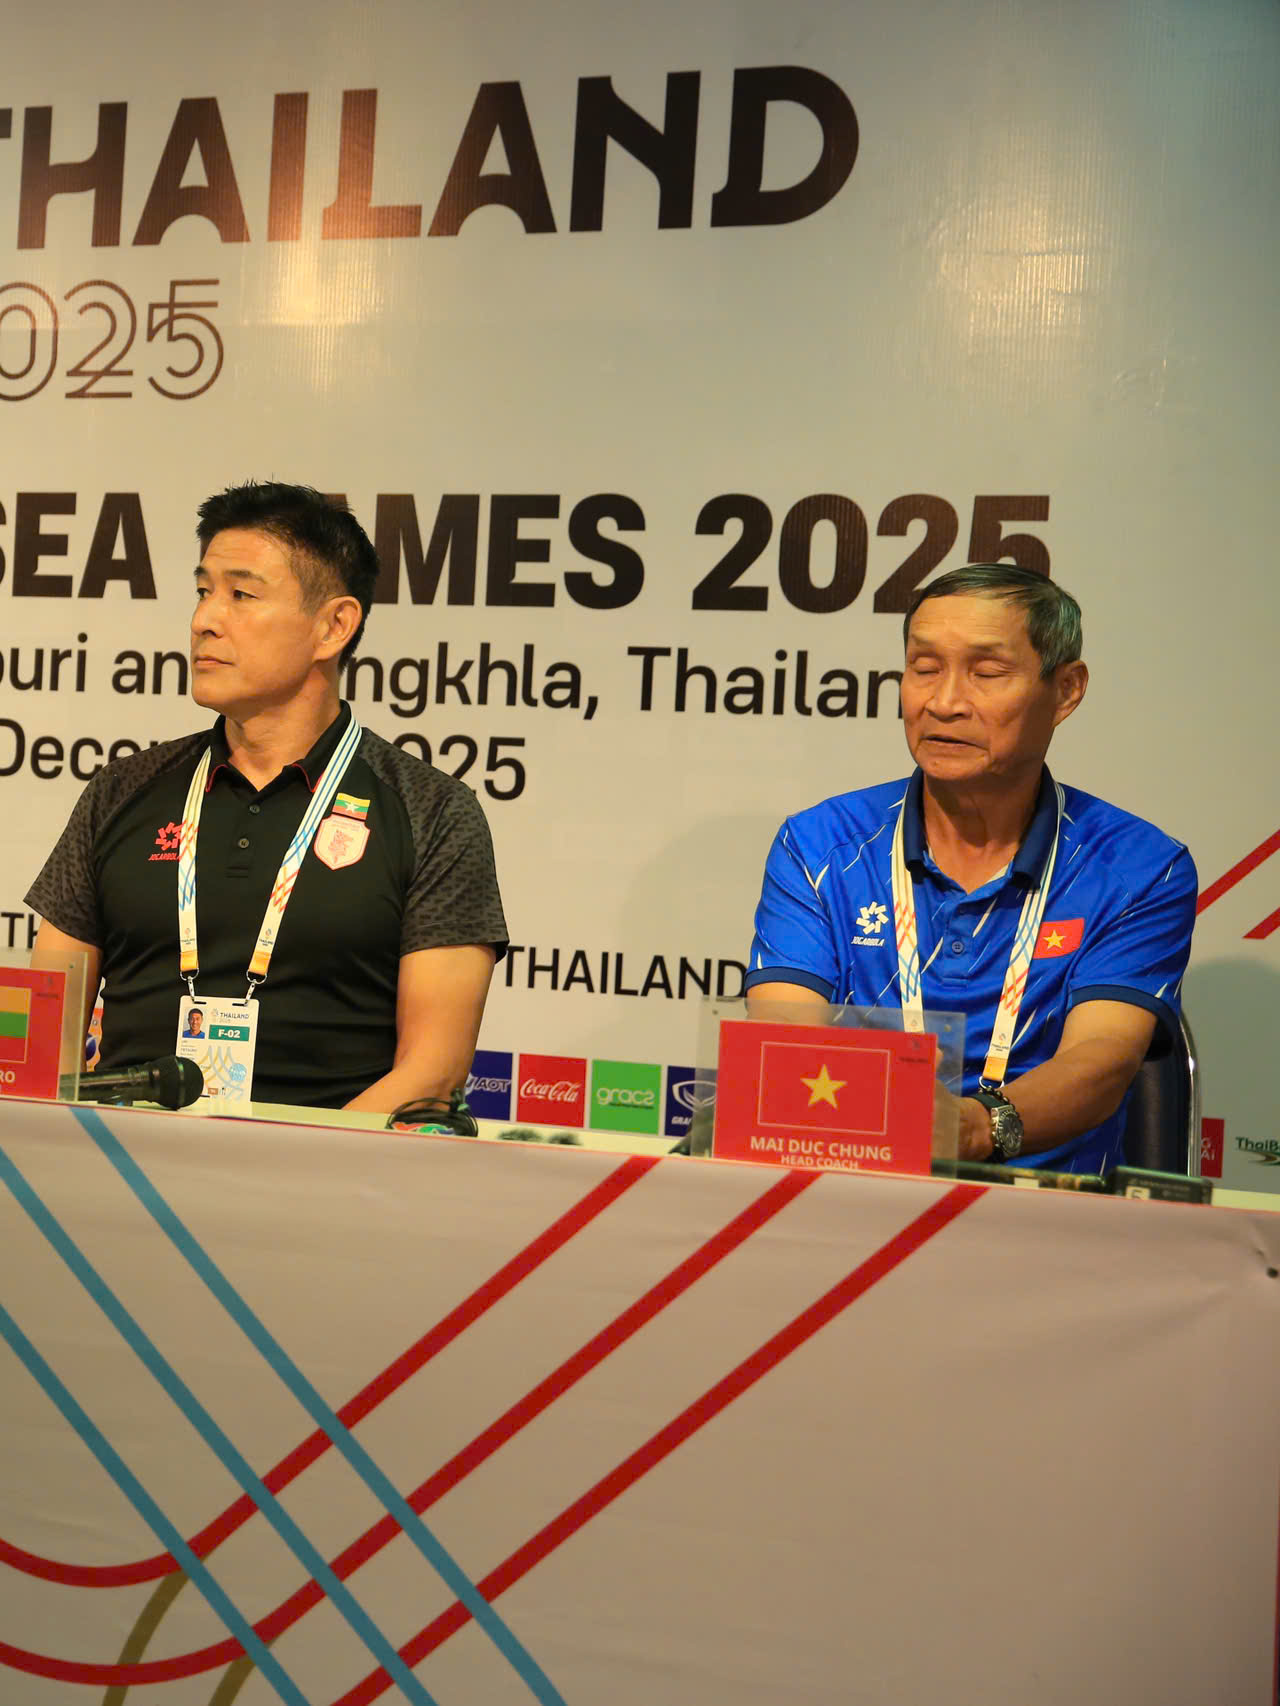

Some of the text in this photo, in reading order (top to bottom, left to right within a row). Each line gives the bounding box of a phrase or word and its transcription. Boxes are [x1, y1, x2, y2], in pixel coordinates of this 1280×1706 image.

[691, 493, 1051, 614] 2025
[626, 645, 904, 720] Thailan
[505, 945, 748, 1002] THAILAND
[219, 1012, 249, 1020] THAILAND
[217, 1029, 241, 1039] F-02
[476, 1077, 512, 1093] AOT
[750, 1135, 892, 1161] MAI DUC CHUNG
[781, 1154, 859, 1170] HEAD COACH
